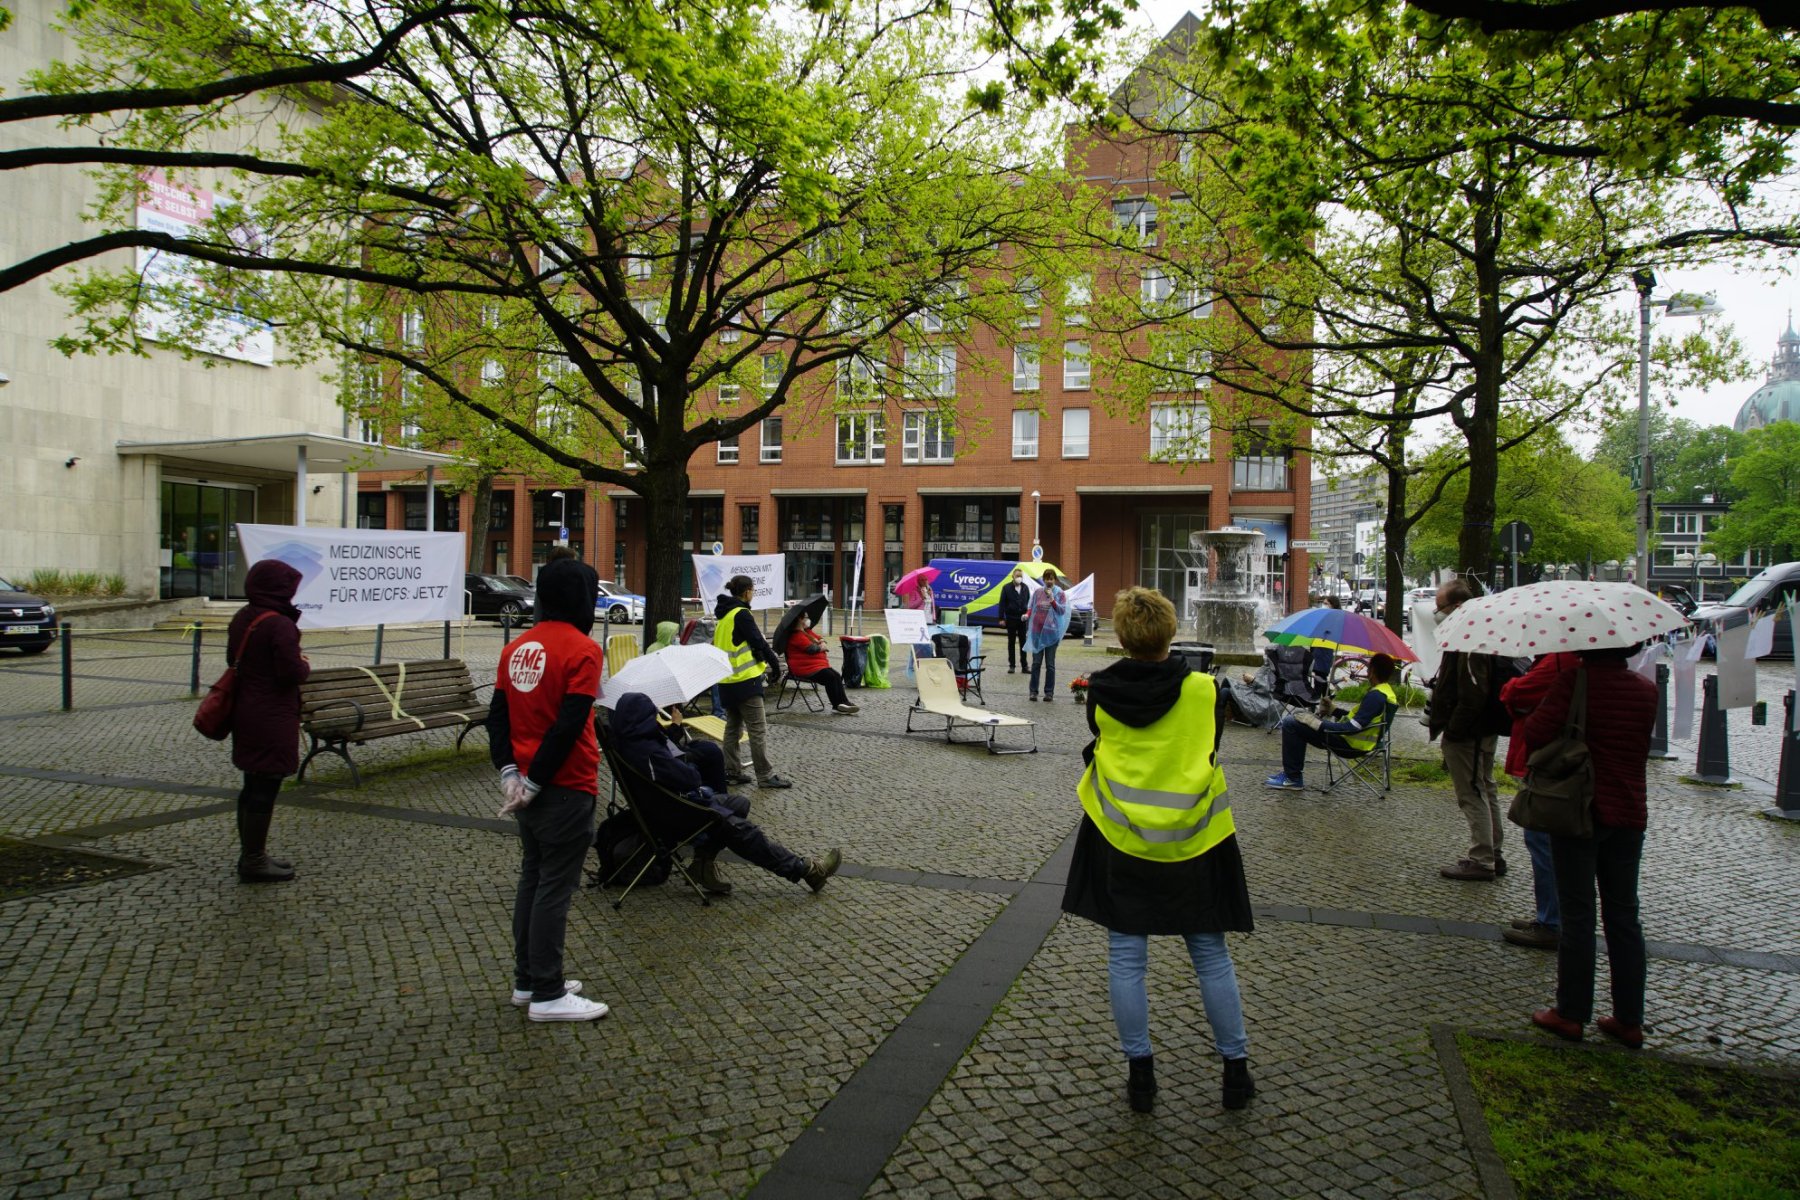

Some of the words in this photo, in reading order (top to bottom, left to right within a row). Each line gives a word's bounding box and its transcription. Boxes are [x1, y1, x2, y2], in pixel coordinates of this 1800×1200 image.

[329, 545, 421, 559] MEDIZINISCHE
[933, 543, 958, 552] OUTLET
[330, 567, 421, 581] VERSORGUNG
[954, 573, 987, 585] Lyreco
[329, 587, 358, 603] FÜR
[361, 588, 410, 602] ME/CFS:
[511, 648, 545, 671] #ME
[511, 671, 543, 685] ACTION
